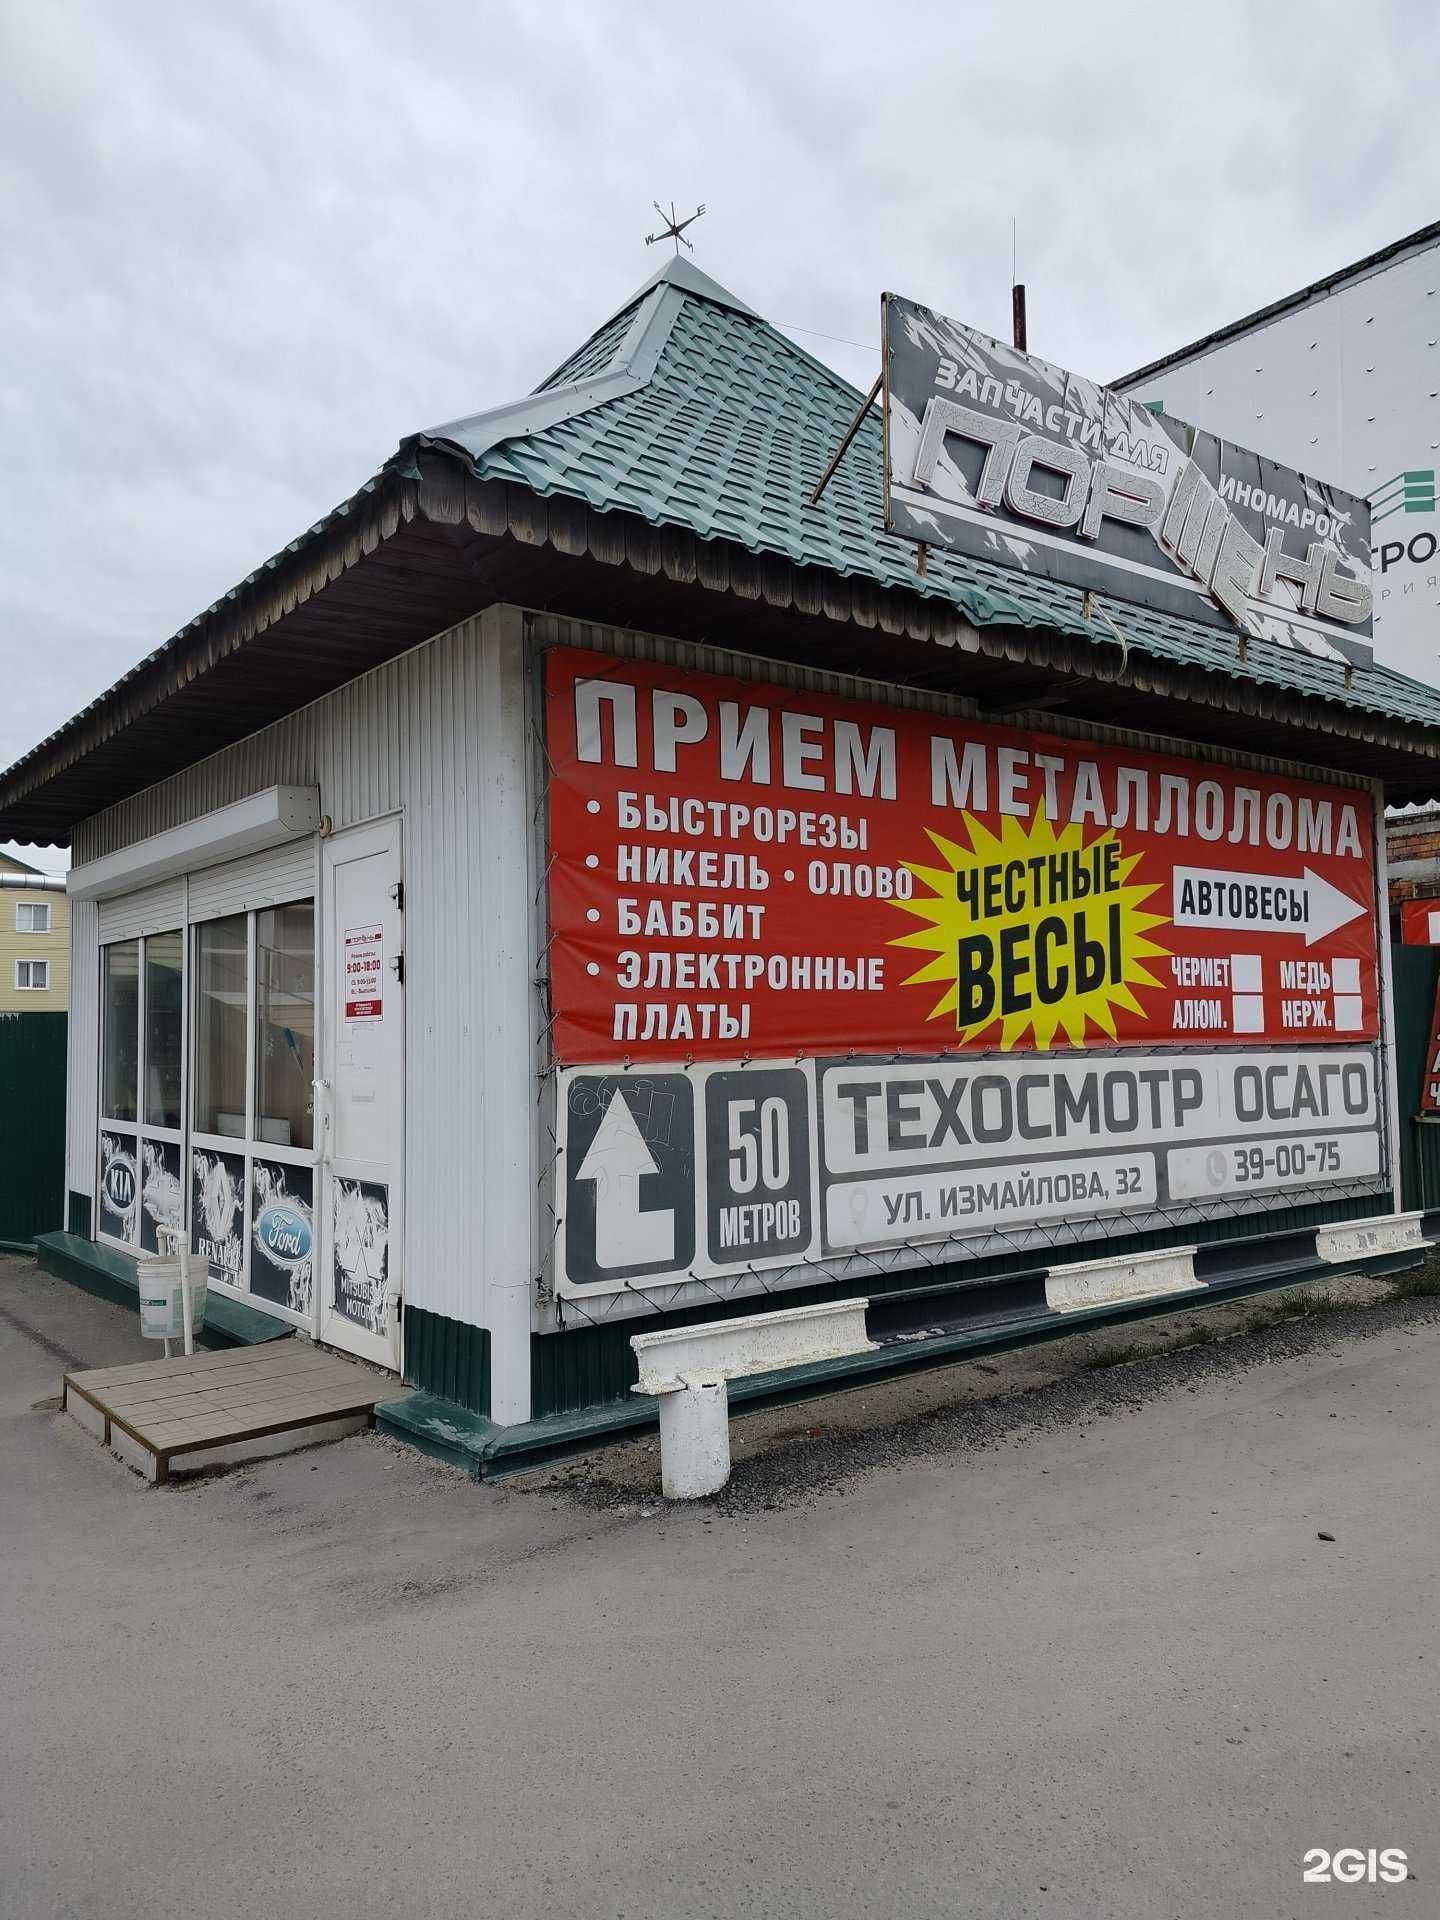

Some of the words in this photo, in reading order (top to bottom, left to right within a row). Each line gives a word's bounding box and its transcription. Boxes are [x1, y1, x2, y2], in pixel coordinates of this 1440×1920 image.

[934, 357, 1102, 449] ЗАПЧАСТИ
[1109, 431, 1169, 475] ДЛЯ
[914, 395, 1373, 626] ПОРШЕНЬ
[1217, 474, 1345, 544] ИНОМАРОК
[575, 678, 898, 801] ПРИЕМ
[930, 736, 1364, 859] МЕТАЛЛОЛОМА
[617, 791, 868, 851] БЫСТРОРЕЗЫ
[617, 845, 770, 890] НИКЕЛЬ
[808, 860, 914, 900] ОЛОВО
[956, 842, 1121, 922] ЧЕСТНЫЕ
[617, 898, 766, 940] БАББИТ
[1180, 878, 1310, 923] АВТОВЕСЫ
[347, 960, 381, 973] 9:00-18:00
[616, 950, 884, 991] ЭЛЕКТРОННЫЕ
[957, 903, 1122, 1029] ВЕСЫ
[1171, 957, 1230, 987] ЧЕРМЕТ
[1279, 960, 1331, 995] МЕДЬ
[612, 1003, 751, 1041] ПЛАТЫ
[1172, 999, 1228, 1029] АЛЮМ.
[1281, 1000, 1333, 1028] НЕРЖ.
[837, 1068, 1203, 1155] ТЕХОСМОТР
[1233, 1062, 1369, 1123] ОСАГО
[728, 1097, 790, 1195] 50
[1233, 1141, 1341, 1182] 39-00-75
[110, 1168, 132, 1203] KIA
[883, 1192, 931, 1226] УЛ.
[940, 1168, 1110, 1218] ИЗМАЙЛОВА,
[1114, 1167, 1142, 1195] 32
[267, 1213, 301, 1255] Ford
[719, 1199, 801, 1248] МЕТРОВ
